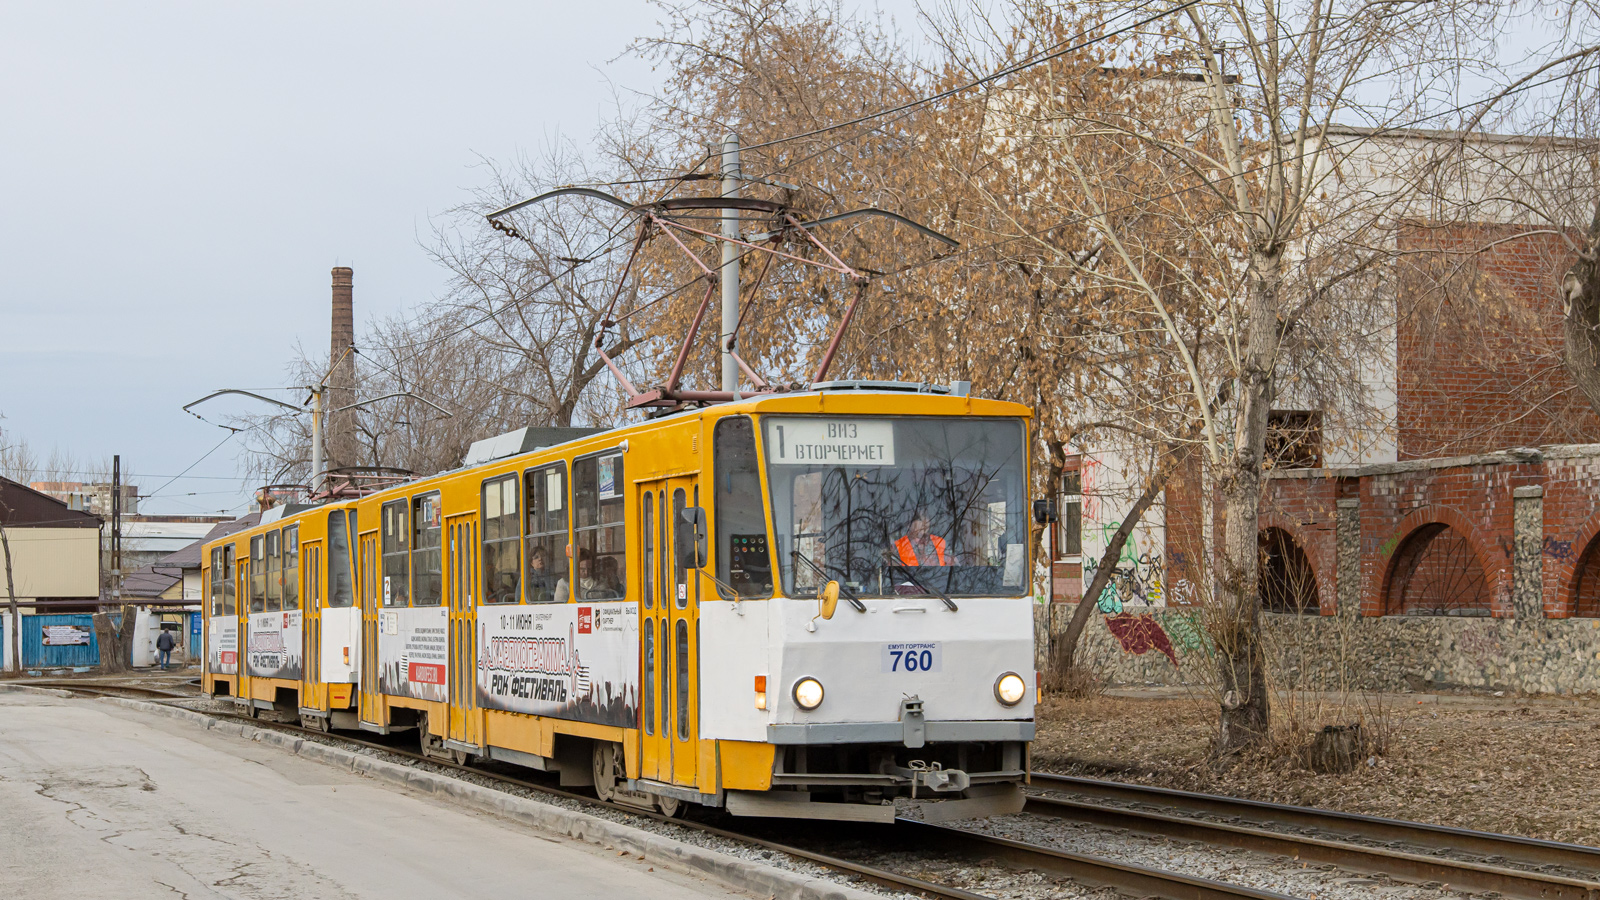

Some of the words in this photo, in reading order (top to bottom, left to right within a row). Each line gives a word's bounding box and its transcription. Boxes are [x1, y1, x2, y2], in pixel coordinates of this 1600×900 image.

[776, 425, 785, 458] 1
[828, 423, 857, 438] ВИЗ
[796, 444, 884, 460] ВТОРЧЕРМЕТ
[500, 614, 506, 630] 10
[515, 613, 532, 630] ИЮНЯ
[491, 636, 567, 675] КАРДИОГРАММА
[890, 650, 932, 672] 760
[491, 674, 509, 696] РОК
[511, 676, 567, 702] ФЕСТИВАЛЬ
